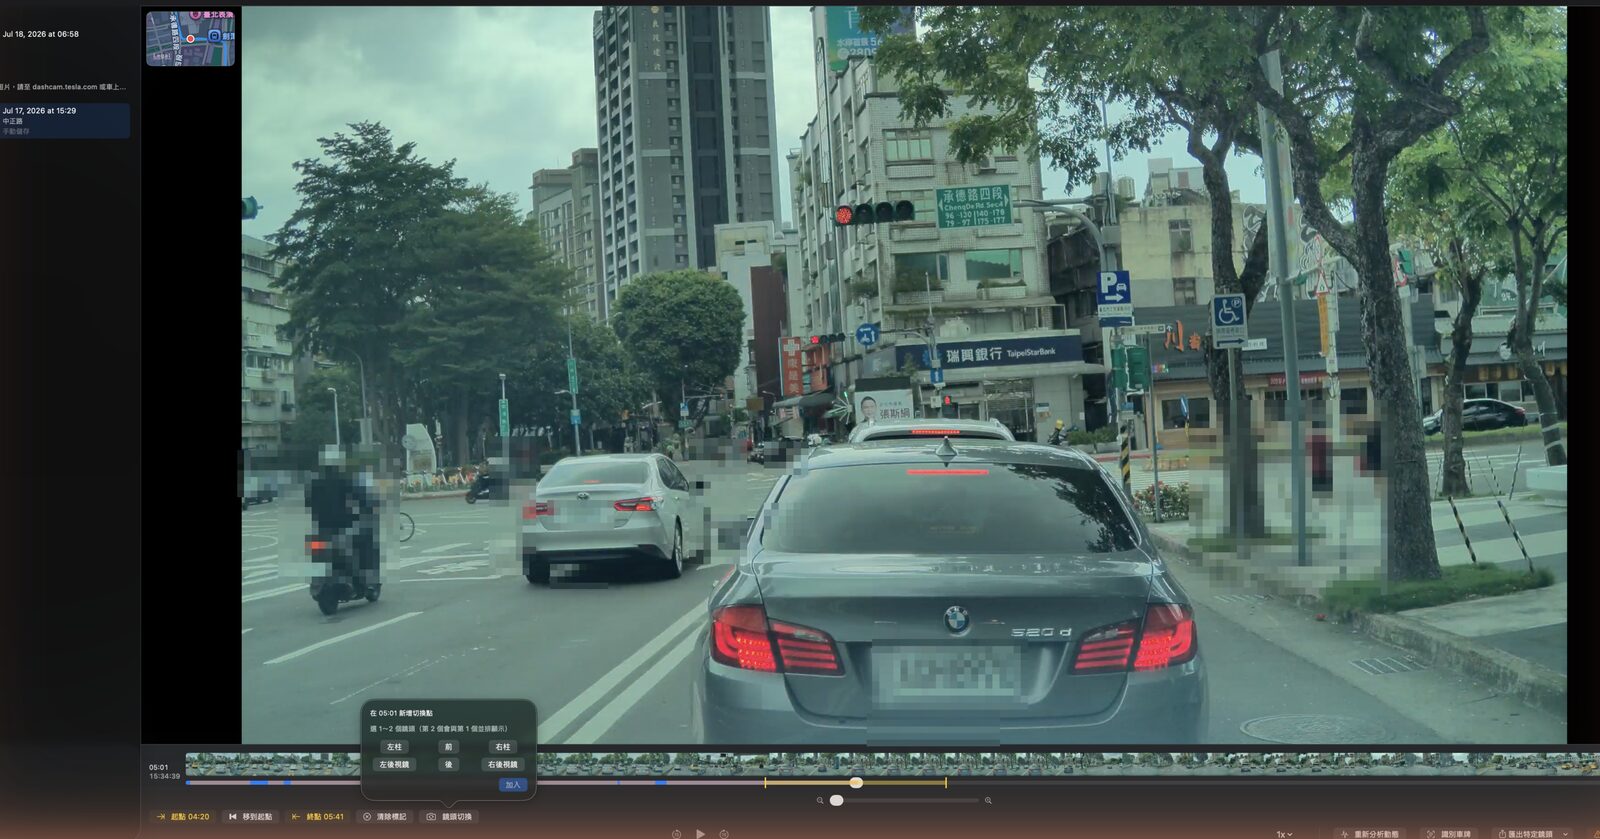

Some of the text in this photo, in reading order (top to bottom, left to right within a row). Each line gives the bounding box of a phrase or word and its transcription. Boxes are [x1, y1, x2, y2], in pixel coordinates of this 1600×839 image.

[15, 31, 26, 39] 18,
[15, 107, 25, 115] 17,
[2, 117, 23, 125] 中正路
[943, 186, 1003, 203] 承德路四段
[1101, 272, 1117, 293] P
[946, 347, 1056, 363] 瑞興銀行 TaipeiStarBank
[370, 709, 377, 717] 在
[399, 709, 433, 717] 新增切換點
[370, 725, 377, 733] 選
[387, 743, 402, 751] 左柱
[445, 743, 453, 751] 前
[495, 743, 511, 751] 右柱
[379, 761, 410, 769] 左後視鏡
[445, 761, 453, 769] 後
[487, 761, 518, 769] 右後視鏡
[505, 781, 521, 789] 加入
[170, 813, 186, 821] 起點
[242, 813, 273, 821] 移到起點
[306, 813, 322, 821] 終點
[376, 813, 407, 821] 清除標記
[442, 813, 473, 821] 鏡頭切換
[1276, 831, 1286, 839] 1x
[1354, 830, 1399, 839] 重新分析動態
[1441, 830, 1471, 839] 識別車牌
[1508, 830, 1553, 839] 匯出特定鏡頭
